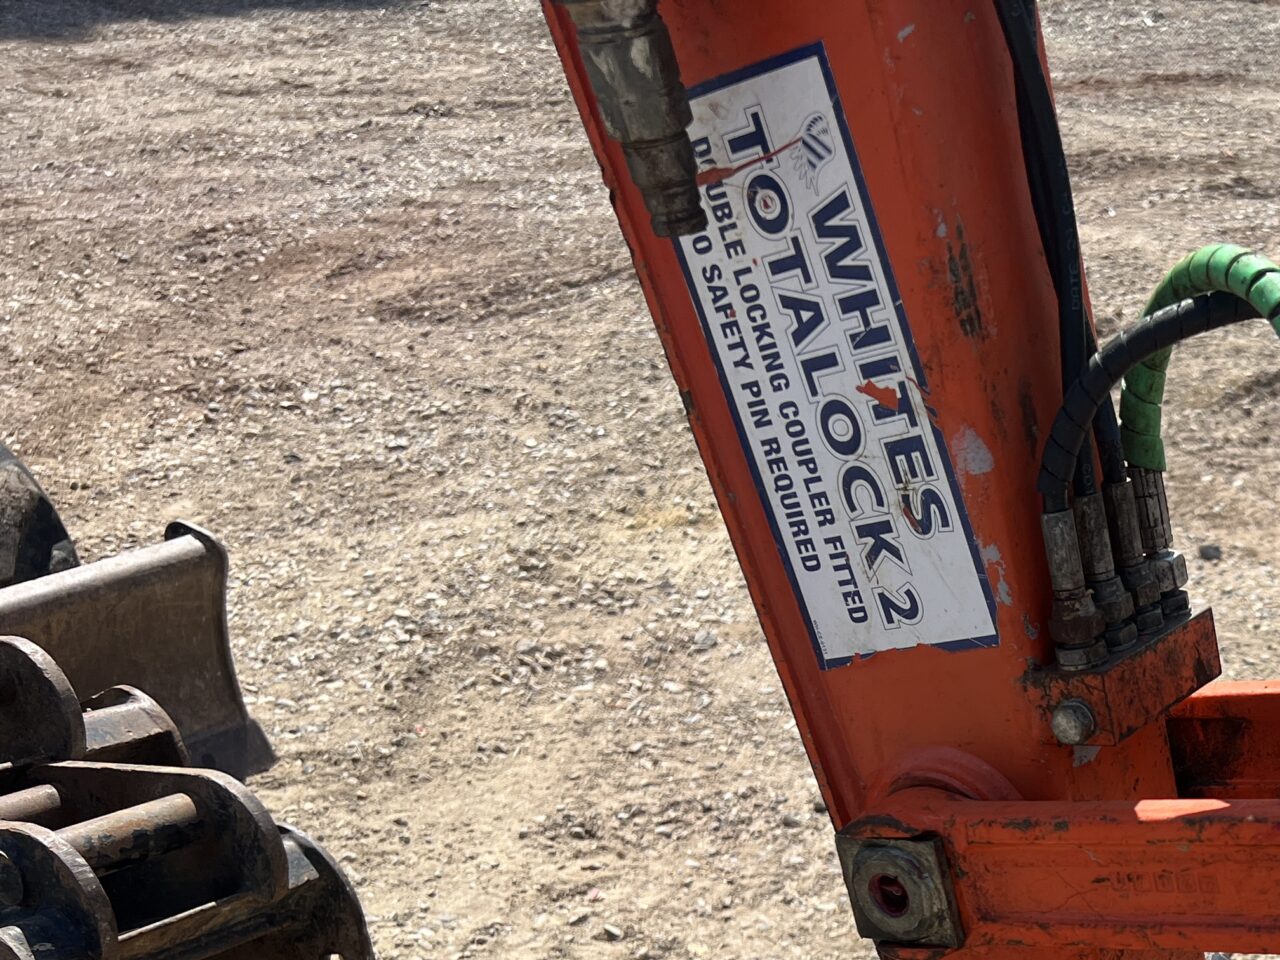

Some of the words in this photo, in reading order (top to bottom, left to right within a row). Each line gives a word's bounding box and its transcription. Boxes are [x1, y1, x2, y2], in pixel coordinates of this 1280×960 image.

[693, 137, 747, 261] DUBLE
[734, 257, 791, 392] LOCKING
[778, 401, 836, 529] COUPLER
[824, 533, 869, 624] FITTED
[702, 265, 753, 371] SAFETY
[741, 380, 772, 430] PIN
[761, 435, 821, 573] REQUIRED
[722, 105, 912, 584] TOTALOCK
[874, 581, 924, 632] 2
[808, 184, 955, 540] WHITES
